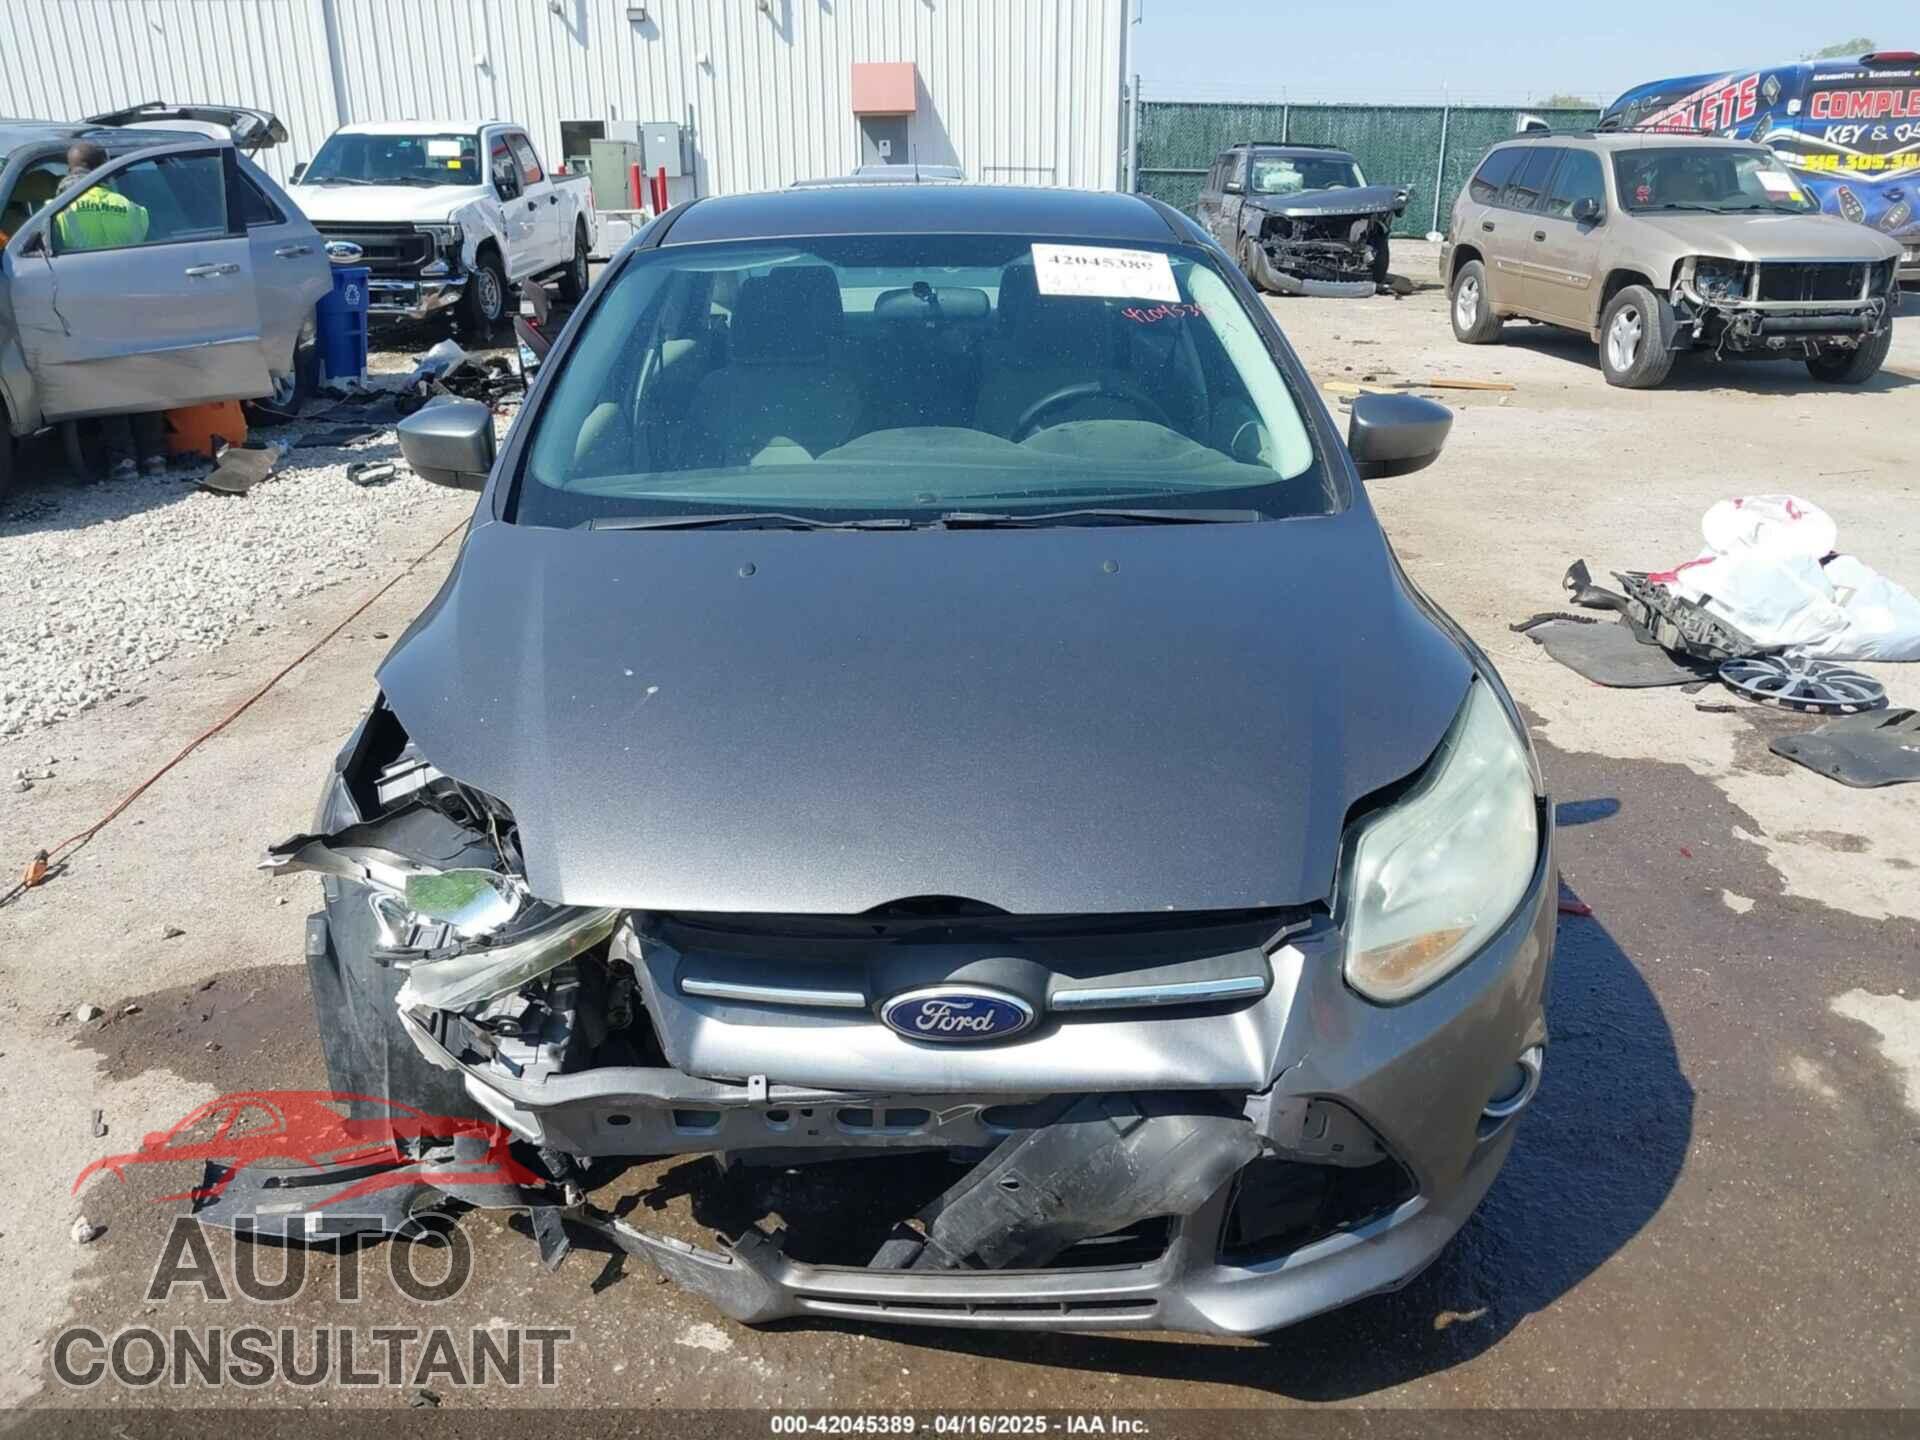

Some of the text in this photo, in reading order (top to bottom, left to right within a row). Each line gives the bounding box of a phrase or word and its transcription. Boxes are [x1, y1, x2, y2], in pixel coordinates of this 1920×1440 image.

[1823, 123, 1869, 144] KEY
[1871, 125, 1888, 141] &
[915, 1000, 995, 1032] Ford
